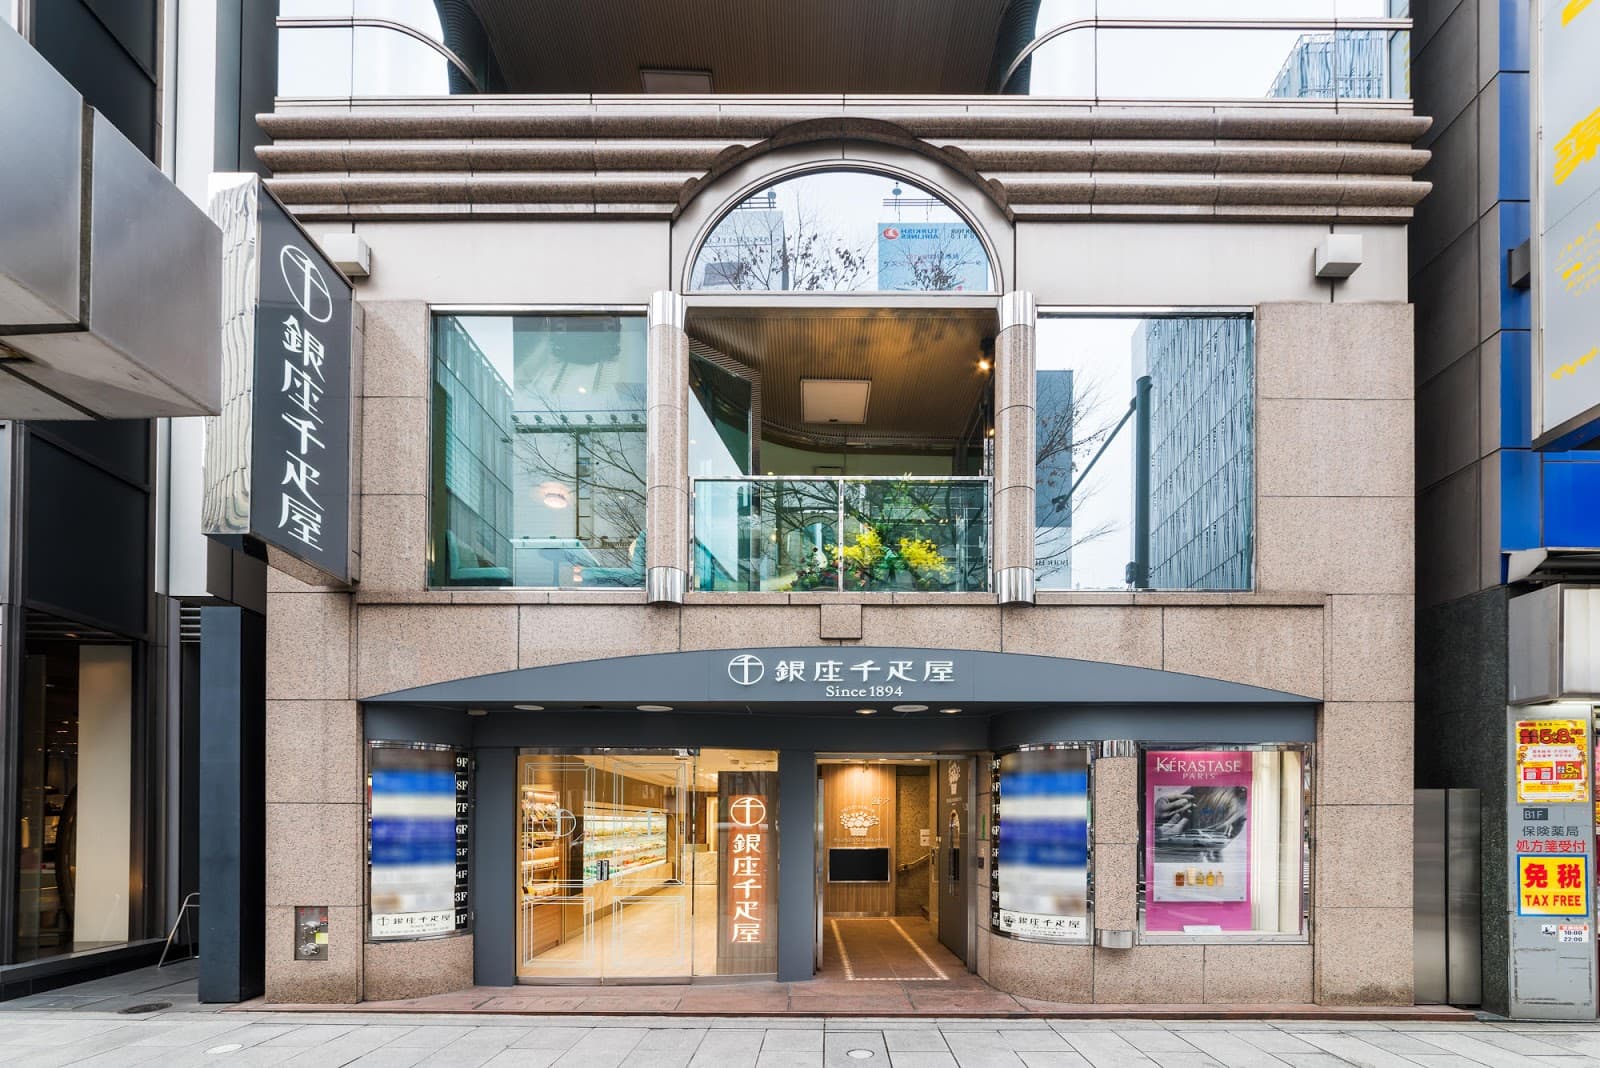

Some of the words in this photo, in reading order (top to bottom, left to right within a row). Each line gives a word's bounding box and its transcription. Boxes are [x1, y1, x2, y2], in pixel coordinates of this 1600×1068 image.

[278, 314, 326, 552] 銀座千疋屋
[775, 660, 955, 682] 銀座千疋屋
[825, 685, 867, 697] Since
[869, 685, 903, 697] 1894
[457, 757, 468, 767] 9F
[1156, 757, 1241, 773] KÉRASTASE
[456, 781, 468, 790] 8F
[457, 803, 468, 812] 7F
[1524, 810, 1543, 819] B1F
[456, 824, 468, 834] 6F
[1522, 826, 1579, 837] 保険薬局
[456, 848, 467, 856] 5F
[1516, 840, 1586, 853] 処方箋受付
[456, 870, 467, 879] 4F
[1524, 863, 1582, 888] 免税
[731, 833, 762, 943] 銀座千疋屋
[455, 892, 467, 901] 3F
[1525, 895, 1549, 906] TAX
[1553, 895, 1581, 906] FREE
[456, 914, 467, 925] 1F
